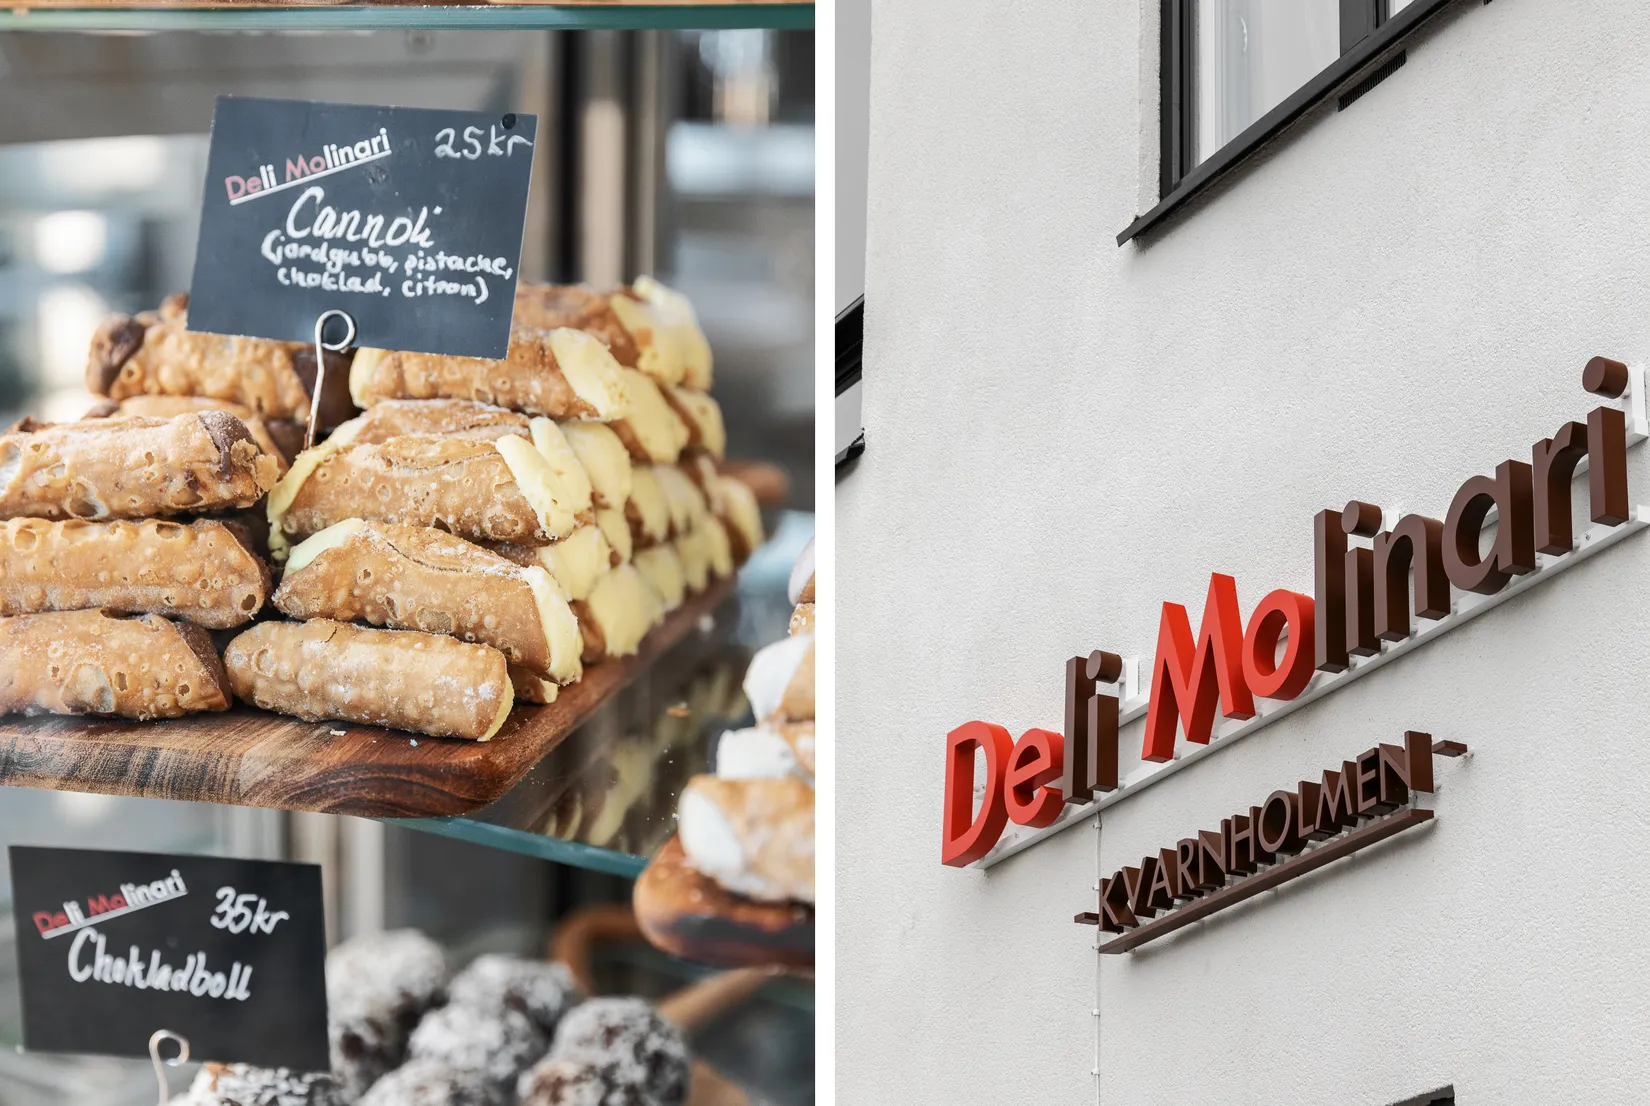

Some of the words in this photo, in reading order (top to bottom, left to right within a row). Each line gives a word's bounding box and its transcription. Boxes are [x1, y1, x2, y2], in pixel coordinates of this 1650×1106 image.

[224, 164, 278, 201] Deli
[285, 128, 391, 182] Molinari
[285, 186, 443, 248] Cannoli
[402, 276, 489, 305] citron)
[942, 650, 1122, 868] Deli
[1141, 356, 1630, 763] Molinari
[1099, 730, 1434, 933] KVARNHOLMEN
[32, 900, 85, 934] Deli
[88, 869, 188, 916] Molinari
[210, 886, 290, 934] 35kr
[68, 927, 252, 1001] Chokladboll
